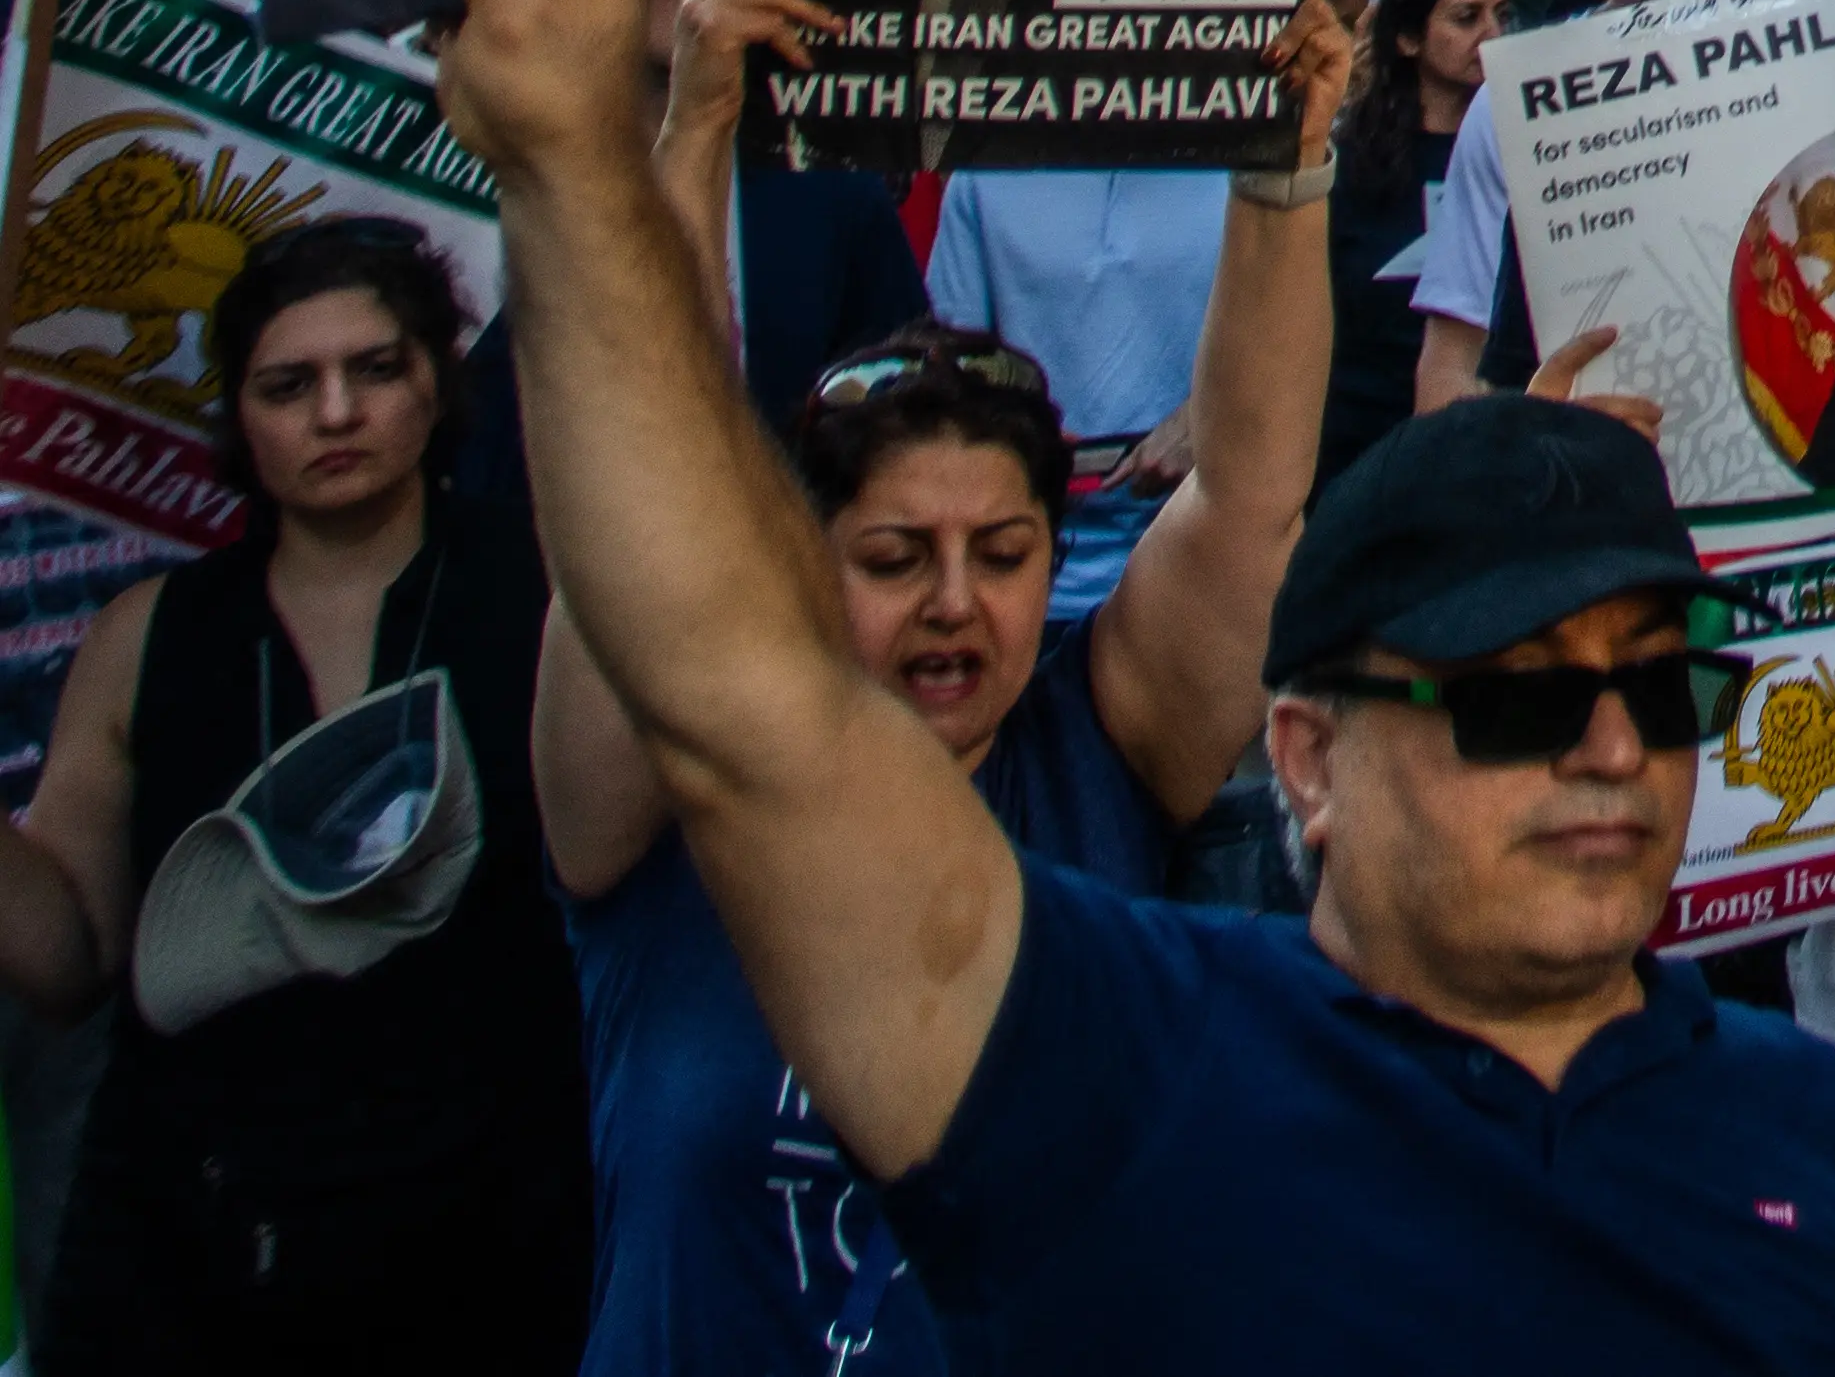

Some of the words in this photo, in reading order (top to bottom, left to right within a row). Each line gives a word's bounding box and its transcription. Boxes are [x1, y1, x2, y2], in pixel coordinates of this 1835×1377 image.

[913, 12, 1013, 49] IRAN
[1023, 13, 1163, 51] GREAT
[140, 14, 286, 107] IRAN
[267, 63, 428, 162] GREAT
[402, 119, 501, 202] AGA
[769, 72, 905, 118] WITH
[923, 76, 1058, 121] REZA
[1071, 75, 1279, 121] PAHLAVI
[1521, 50, 1679, 122] REZA
[1532, 139, 1572, 166] for
[1578, 106, 1722, 152] secularism
[1728, 83, 1780, 118] and
[1541, 151, 1691, 205] democracy
[1548, 218, 1573, 245] in
[1580, 205, 1636, 237] Iran
[1677, 886, 1775, 933] Long
